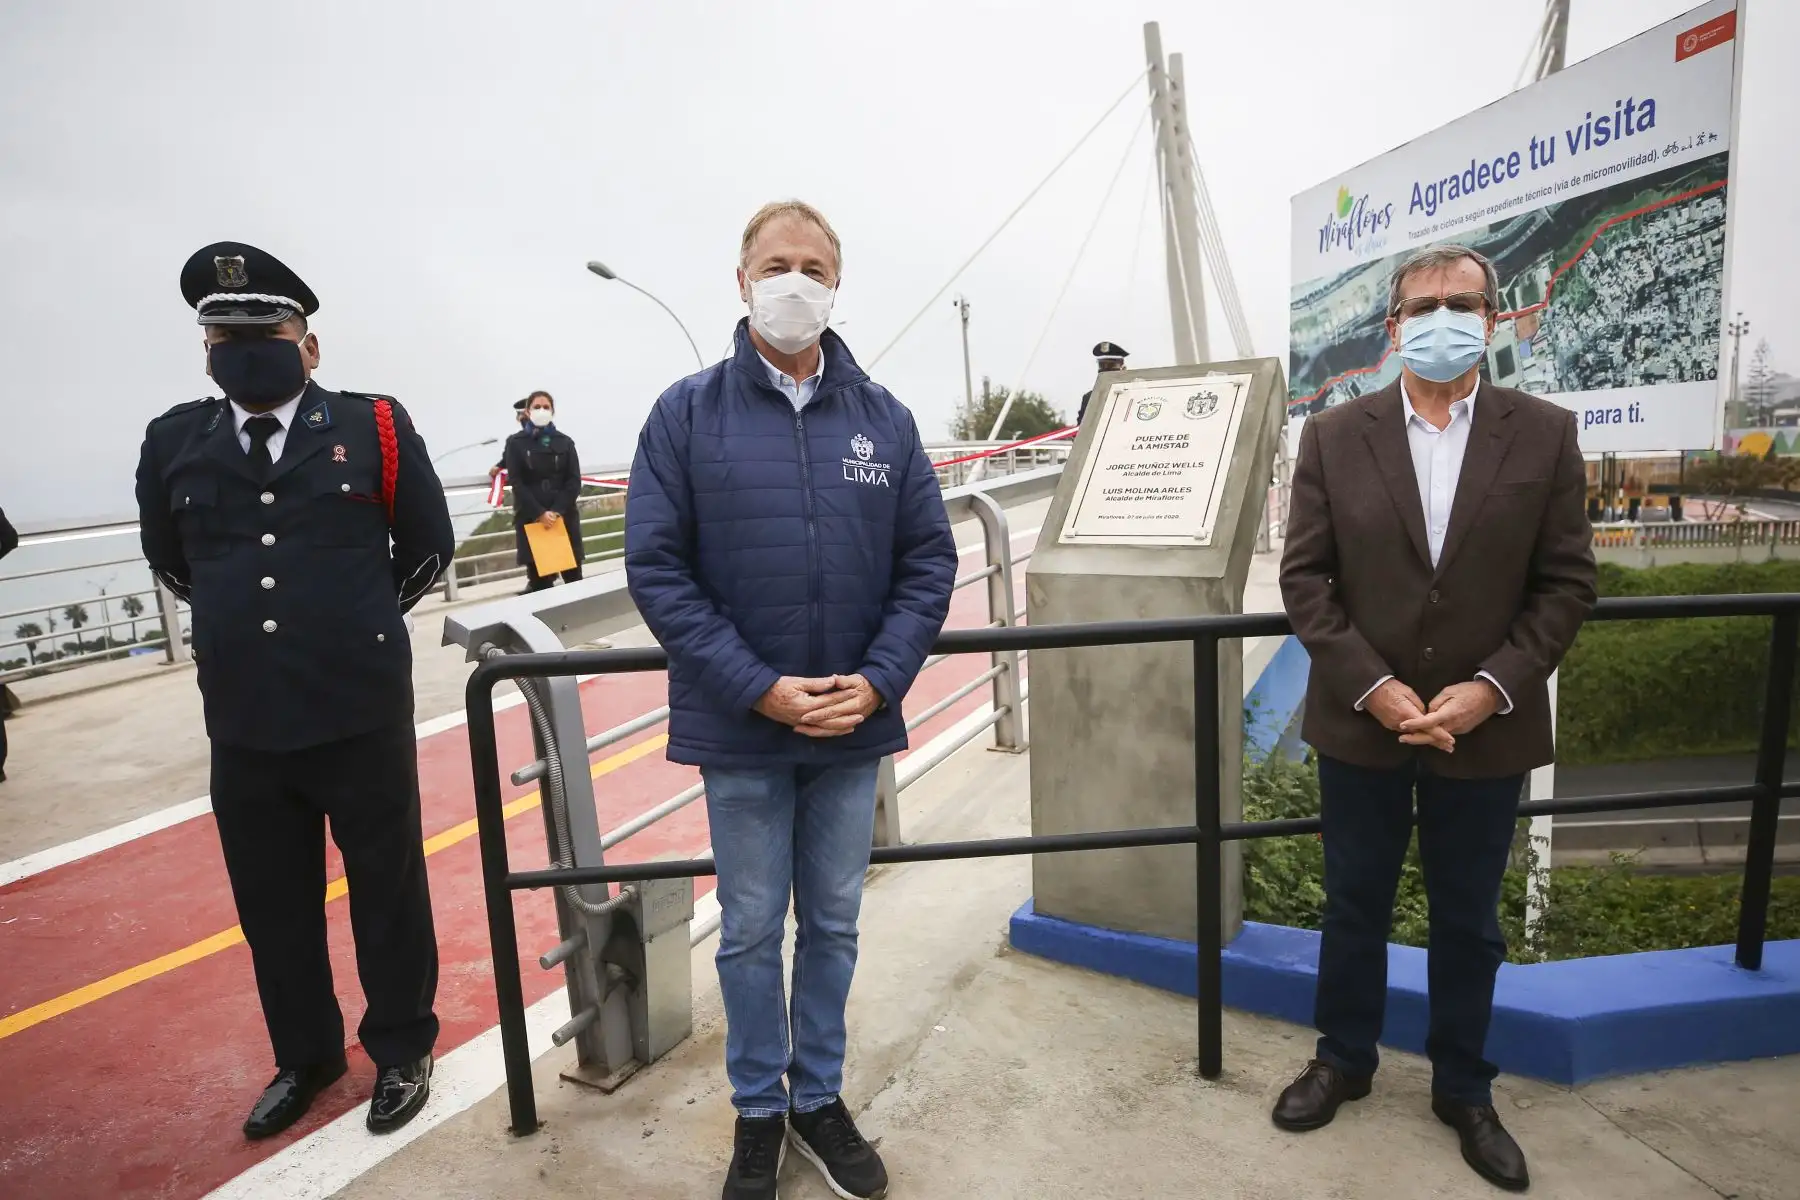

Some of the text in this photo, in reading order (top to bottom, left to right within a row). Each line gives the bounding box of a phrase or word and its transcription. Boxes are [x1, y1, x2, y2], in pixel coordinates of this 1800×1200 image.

[1409, 96, 1656, 217] Agradece tu visita
[1431, 224, 1439, 233] de
[1487, 196, 1524, 215] expediente
[1571, 175, 1581, 187] de
[1583, 149, 1660, 183] micromovilidad).
[1584, 408, 1622, 430] para
[1628, 401, 1645, 423] ti.
[842, 457, 882, 468] MUNICIPALIDAD
[843, 466, 889, 487] LIMA
